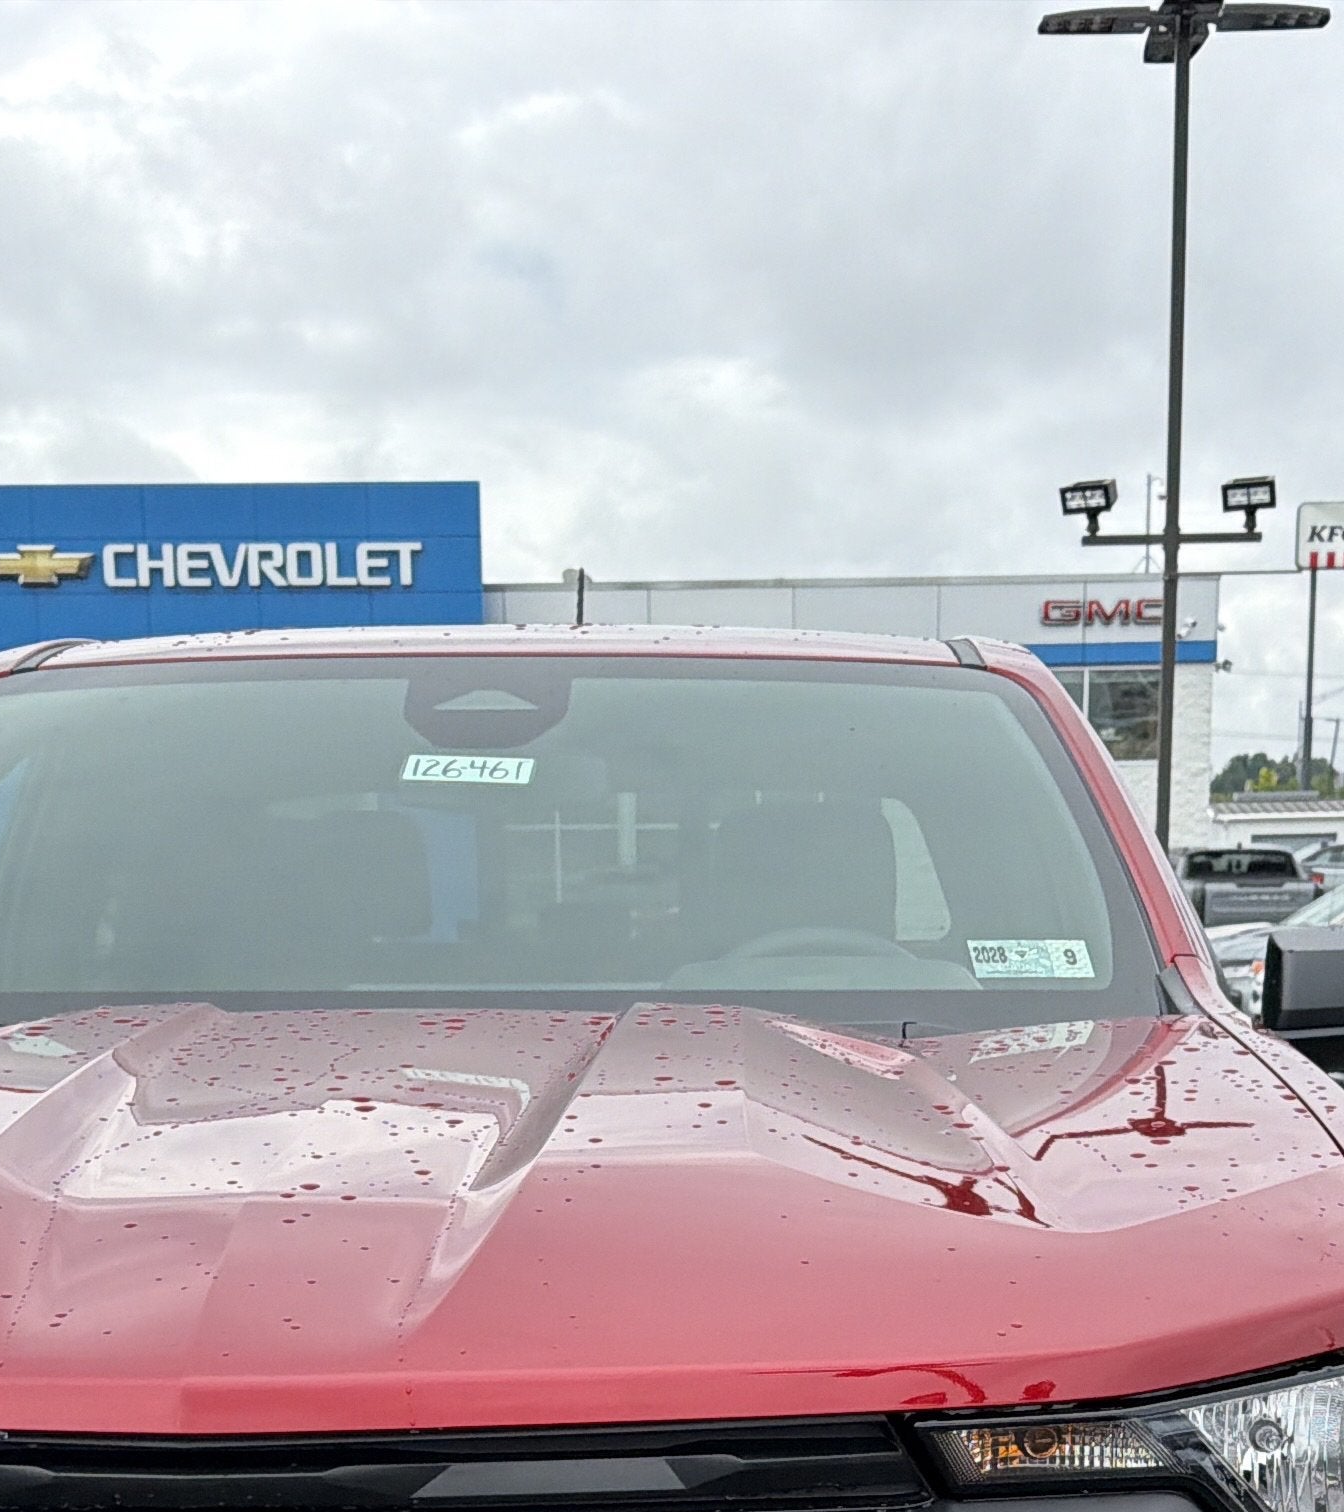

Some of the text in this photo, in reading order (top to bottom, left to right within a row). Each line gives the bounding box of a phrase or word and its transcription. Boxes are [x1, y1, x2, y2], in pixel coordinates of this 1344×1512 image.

[103, 541, 423, 589] CHEVROLET
[1042, 599, 1165, 625] GMC
[972, 945, 1078, 966] 2028 9
